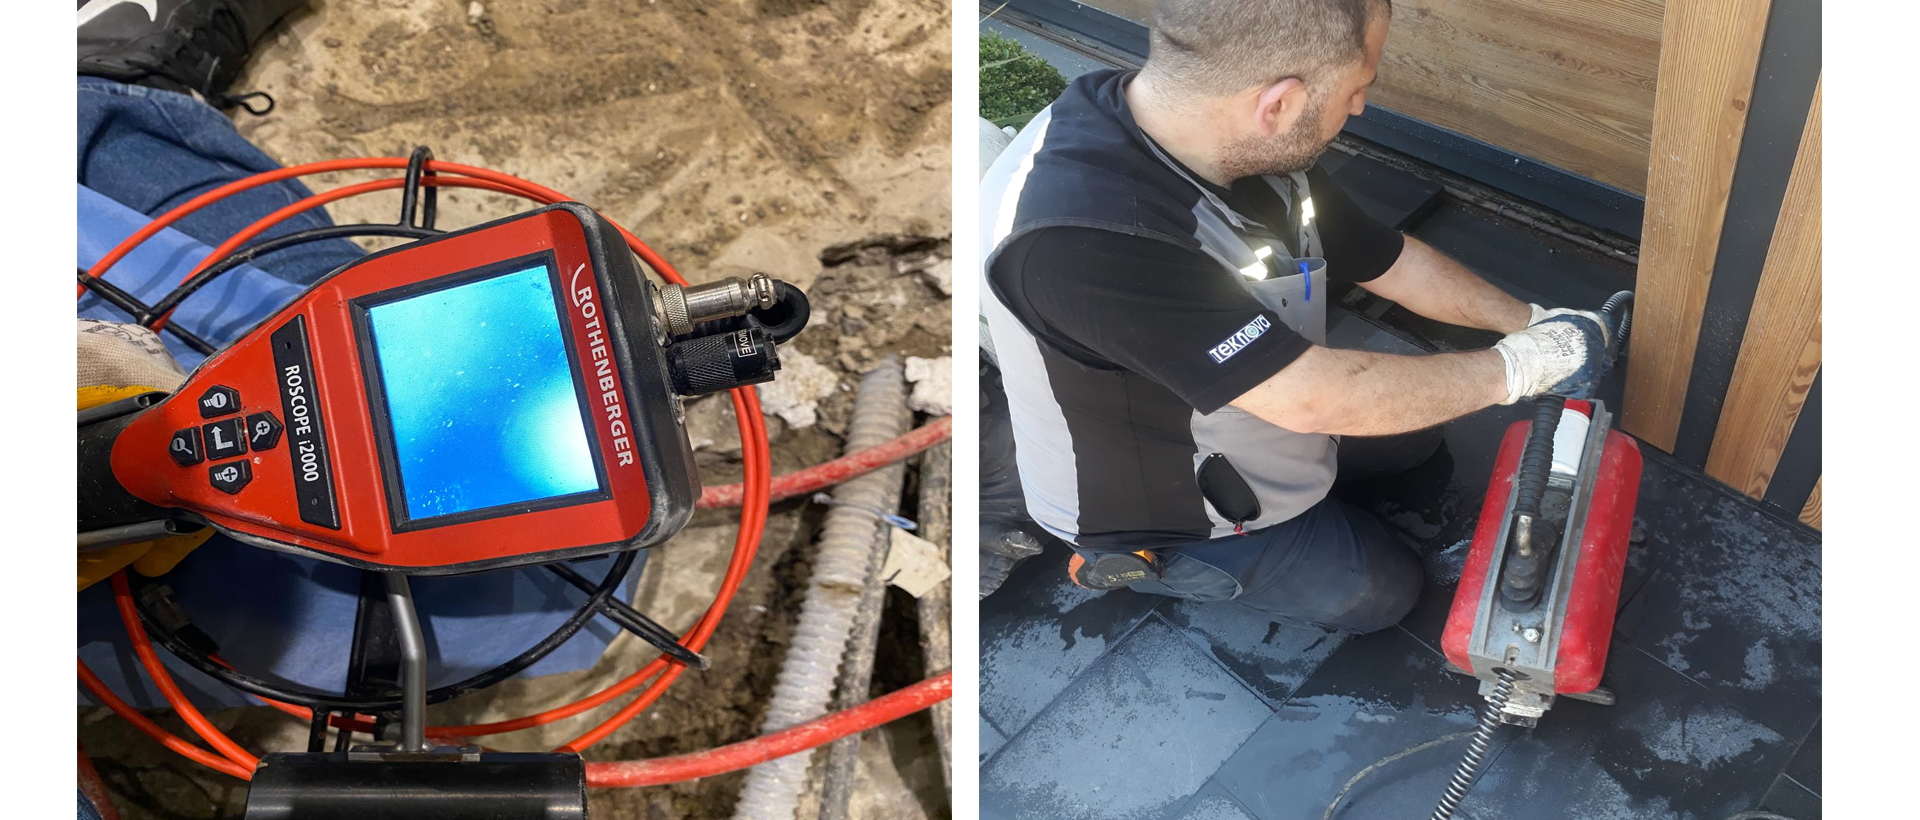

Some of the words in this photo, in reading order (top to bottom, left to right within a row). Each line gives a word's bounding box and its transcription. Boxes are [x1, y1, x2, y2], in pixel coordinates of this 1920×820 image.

[285, 365, 311, 436] ROSCOPE
[298, 440, 319, 482] i2000
[578, 286, 634, 467] ROTHENBERGER
